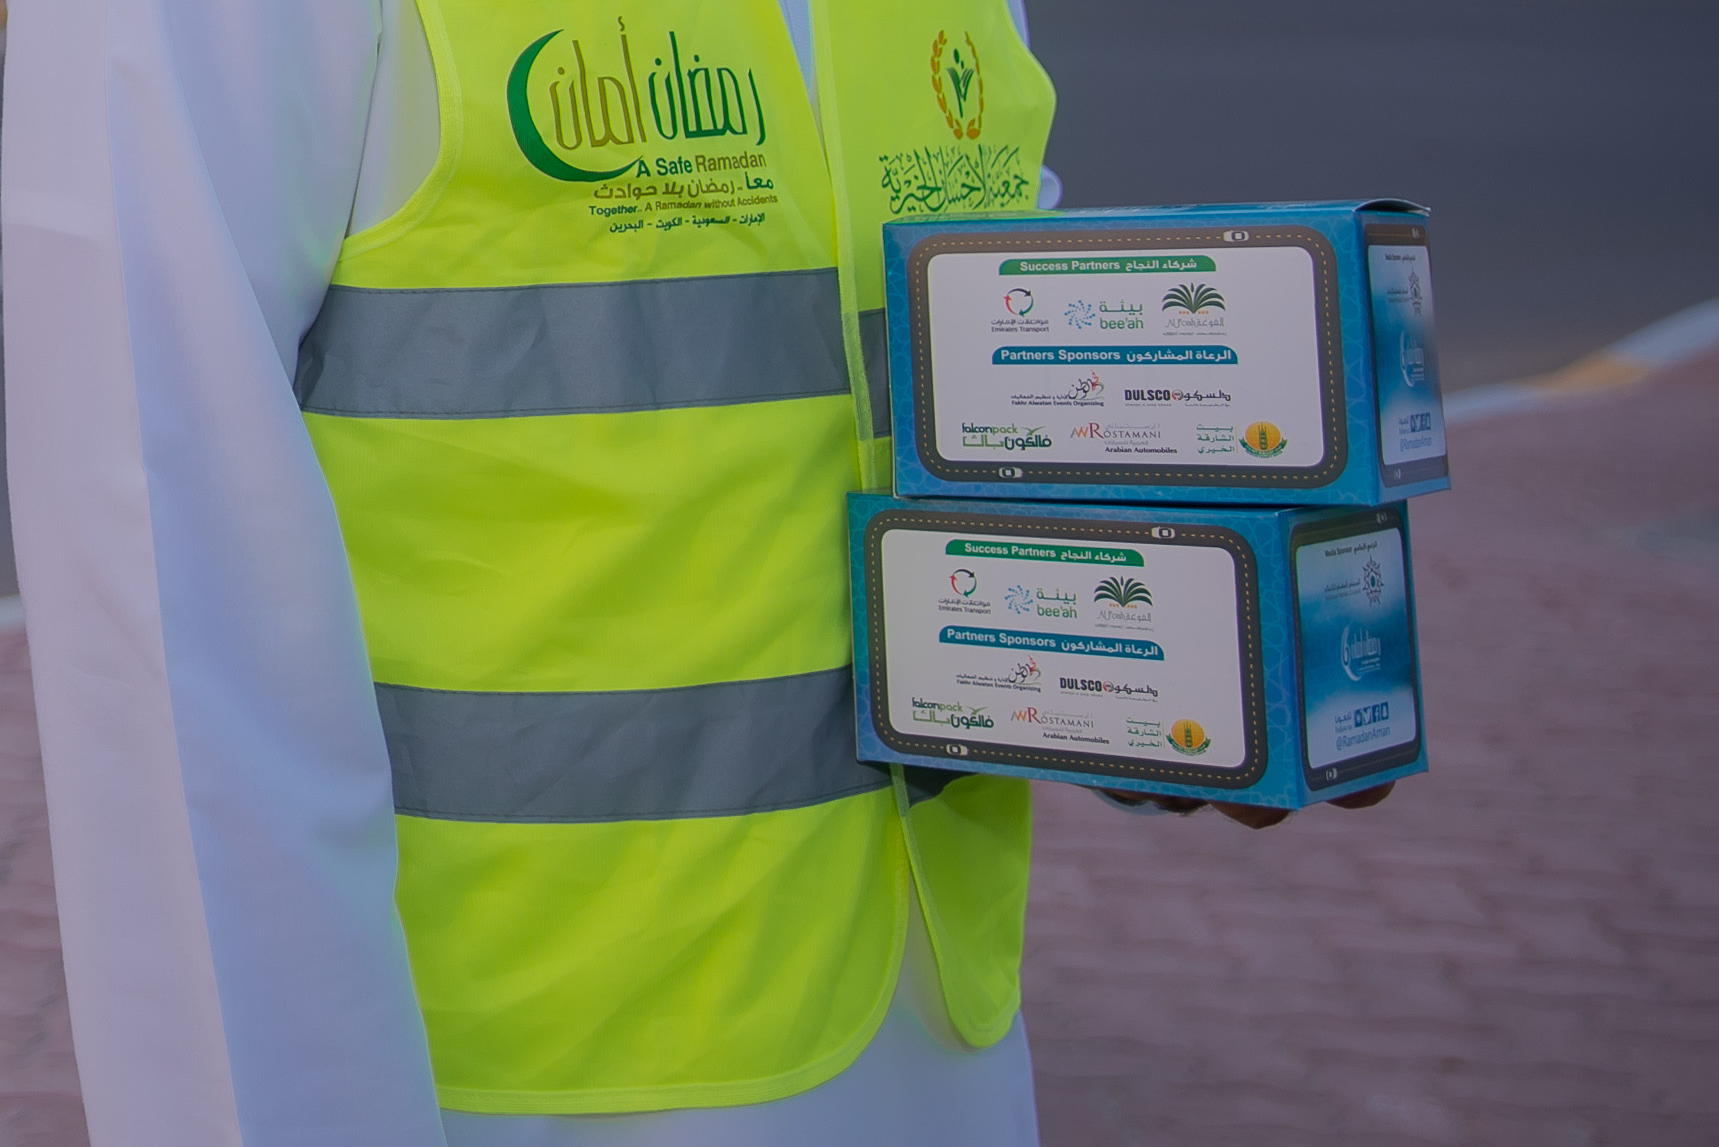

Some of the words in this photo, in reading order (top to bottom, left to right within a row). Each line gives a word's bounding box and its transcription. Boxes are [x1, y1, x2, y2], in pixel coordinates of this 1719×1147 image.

[635, 158, 652, 179] A
[655, 156, 693, 177] Safe
[695, 150, 768, 173] Ramadan
[593, 182, 658, 201] حوادث
[661, 181, 685, 198] بلا
[687, 177, 736, 198] رمضان
[644, 203, 653, 212] A
[655, 200, 702, 211] Ramadan
[703, 197, 736, 209] without
[737, 194, 778, 207] Accidents
[1019, 261, 1068, 272] Success
[1071, 259, 1120, 271] Partners
[1125, 259, 1159, 272] النجاح
[1161, 258, 1198, 270] شركاء
[1098, 299, 1143, 316] بيئة
[1019, 326, 1050, 334] Transport
[1099, 317, 1144, 330] bee'ah
[1000, 349, 1055, 361] Partners
[1058, 349, 1121, 362] Sponsors
[1126, 348, 1193, 363] المشاركون
[1195, 349, 1232, 362] الرعاة
[1124, 389, 1171, 401] DULSCO
[962, 422, 1018, 436] falconpack
[964, 542, 1009, 556] Success
[1011, 545, 1057, 559] Partners
[1060, 549, 1092, 561] النجاح
[1094, 552, 1127, 563] شركاء
[1036, 587, 1077, 605] بيئة
[964, 606, 991, 614] Transport
[1036, 603, 1078, 619] bee'ah
[946, 628, 996, 642] Partners
[999, 632, 1057, 648] Sponsors
[1061, 639, 1123, 653] المشاركون
[1124, 644, 1159, 657] الرعاة
[1060, 677, 1102, 692] DULSCO
[912, 697, 964, 713] falconpack
[1042, 732, 1068, 740] Arabian
[1069, 735, 1110, 744] Automobiles
